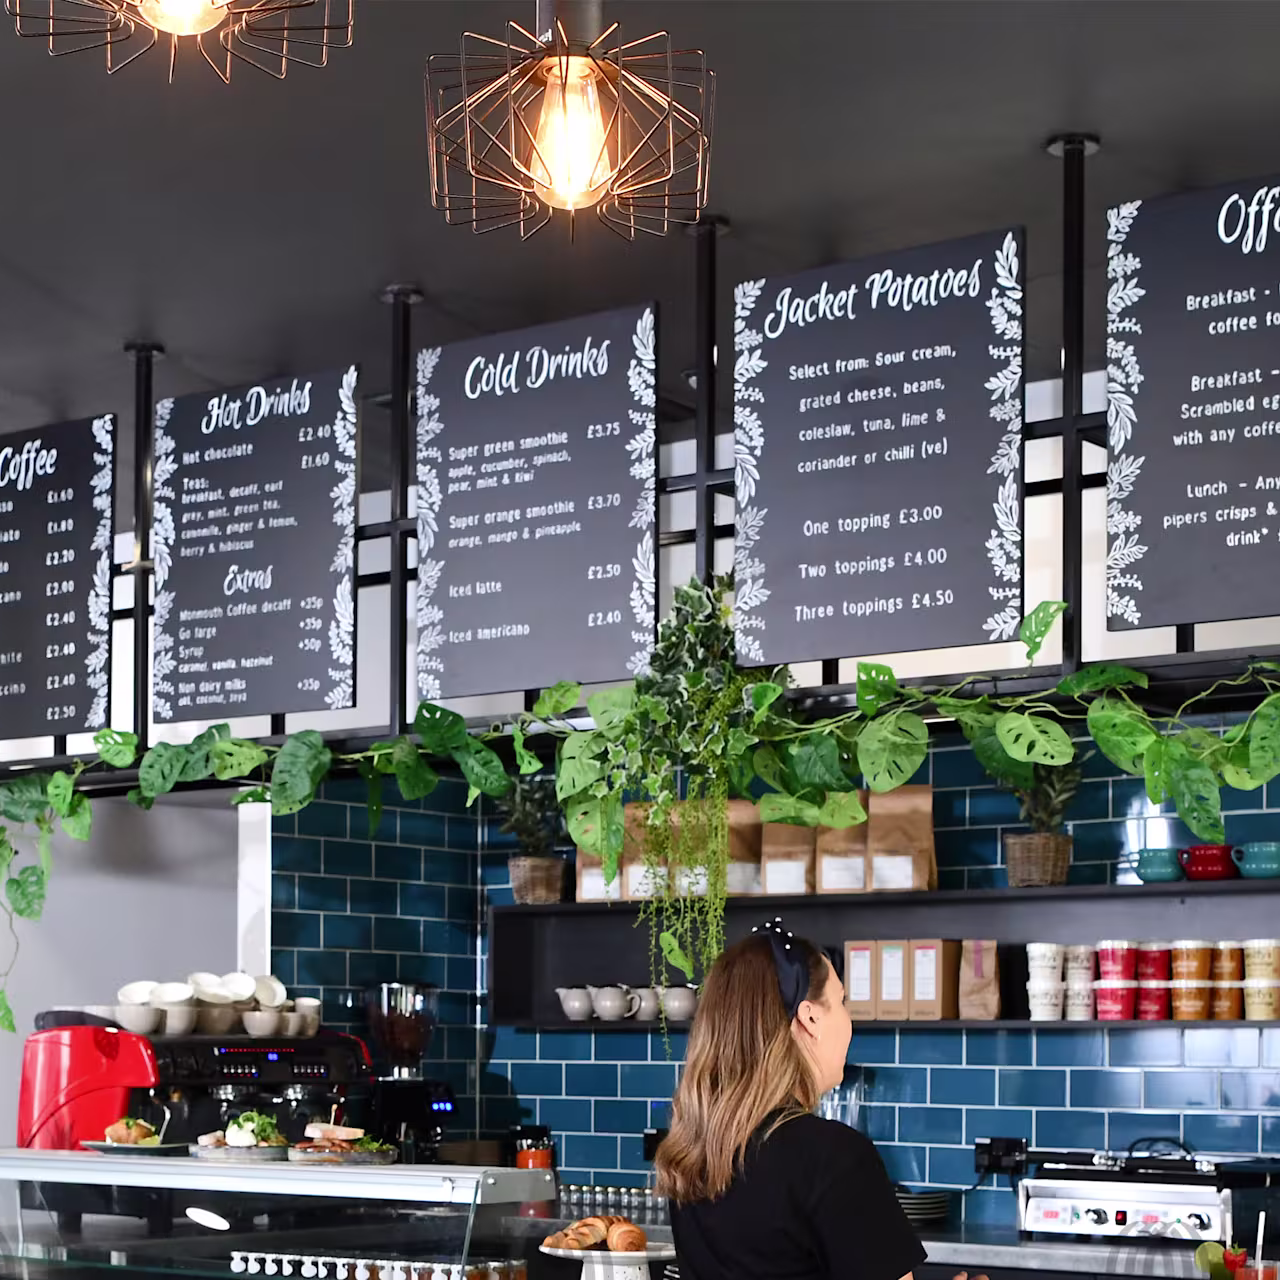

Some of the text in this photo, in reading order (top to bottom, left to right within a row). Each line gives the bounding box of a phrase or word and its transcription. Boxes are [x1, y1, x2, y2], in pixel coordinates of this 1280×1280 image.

[764, 258, 982, 338] Jacket Potatoes
[1186, 287, 1256, 311] Breakfast
[1208, 315, 1258, 335] coffee
[464, 337, 610, 399] Cold Drinks
[789, 345, 956, 380] Select from: Sour cream,
[1191, 369, 1262, 392] Breakfast
[201, 378, 312, 434] Hot Drinks
[800, 378, 944, 412] grated cheese, beans,
[1181, 396, 1255, 419] Scrambled
[798, 408, 946, 441] coleslaw, tuna, lime &
[183, 424, 331, 465] Hot chocolate £2.40
[449, 422, 620, 461] Super green smoothie £3.75
[1173, 430, 1203, 447] with
[1210, 427, 1235, 444] any
[448, 451, 571, 478] apple, cucumber, spinach,
[798, 437, 948, 472] coriander or chilli (ve)
[183, 452, 329, 491] Teas: £1.60
[47, 488, 73, 503] £1.60
[448, 480, 471, 494] pear,
[477, 476, 497, 489] mint
[502, 474, 510, 484] &
[1187, 481, 1227, 499] Lunch
[449, 494, 620, 530] Super orange smoothie £3.70
[804, 506, 942, 536] One topping £3.00
[1163, 510, 1207, 529] pipers
[1216, 505, 1256, 522] crisps
[1266, 502, 1277, 516] &
[47, 519, 73, 534] £1.80
[488, 531, 518, 544] mango
[522, 528, 530, 540] &
[535, 521, 581, 539] pineapple
[46, 549, 75, 565] £2.20
[799, 548, 947, 578] Two toppings £4.00
[46, 581, 74, 596] £2.00
[224, 565, 273, 595] Extras
[449, 564, 621, 598] Iced latte £2.50
[227, 601, 257, 617] Coffee
[262, 599, 291, 613] decaff
[795, 590, 954, 622] Three toppings £4.50
[46, 611, 75, 626] £2.40
[449, 610, 621, 644] Iced americano £2.40
[179, 628, 191, 640] Go
[195, 626, 216, 638] large
[46, 642, 75, 658] £2.40
[179, 645, 204, 659] Syrup
[47, 673, 75, 689] £2.40
[178, 682, 195, 693] Non
[199, 680, 221, 694] dairy
[47, 705, 75, 720] £2.50
